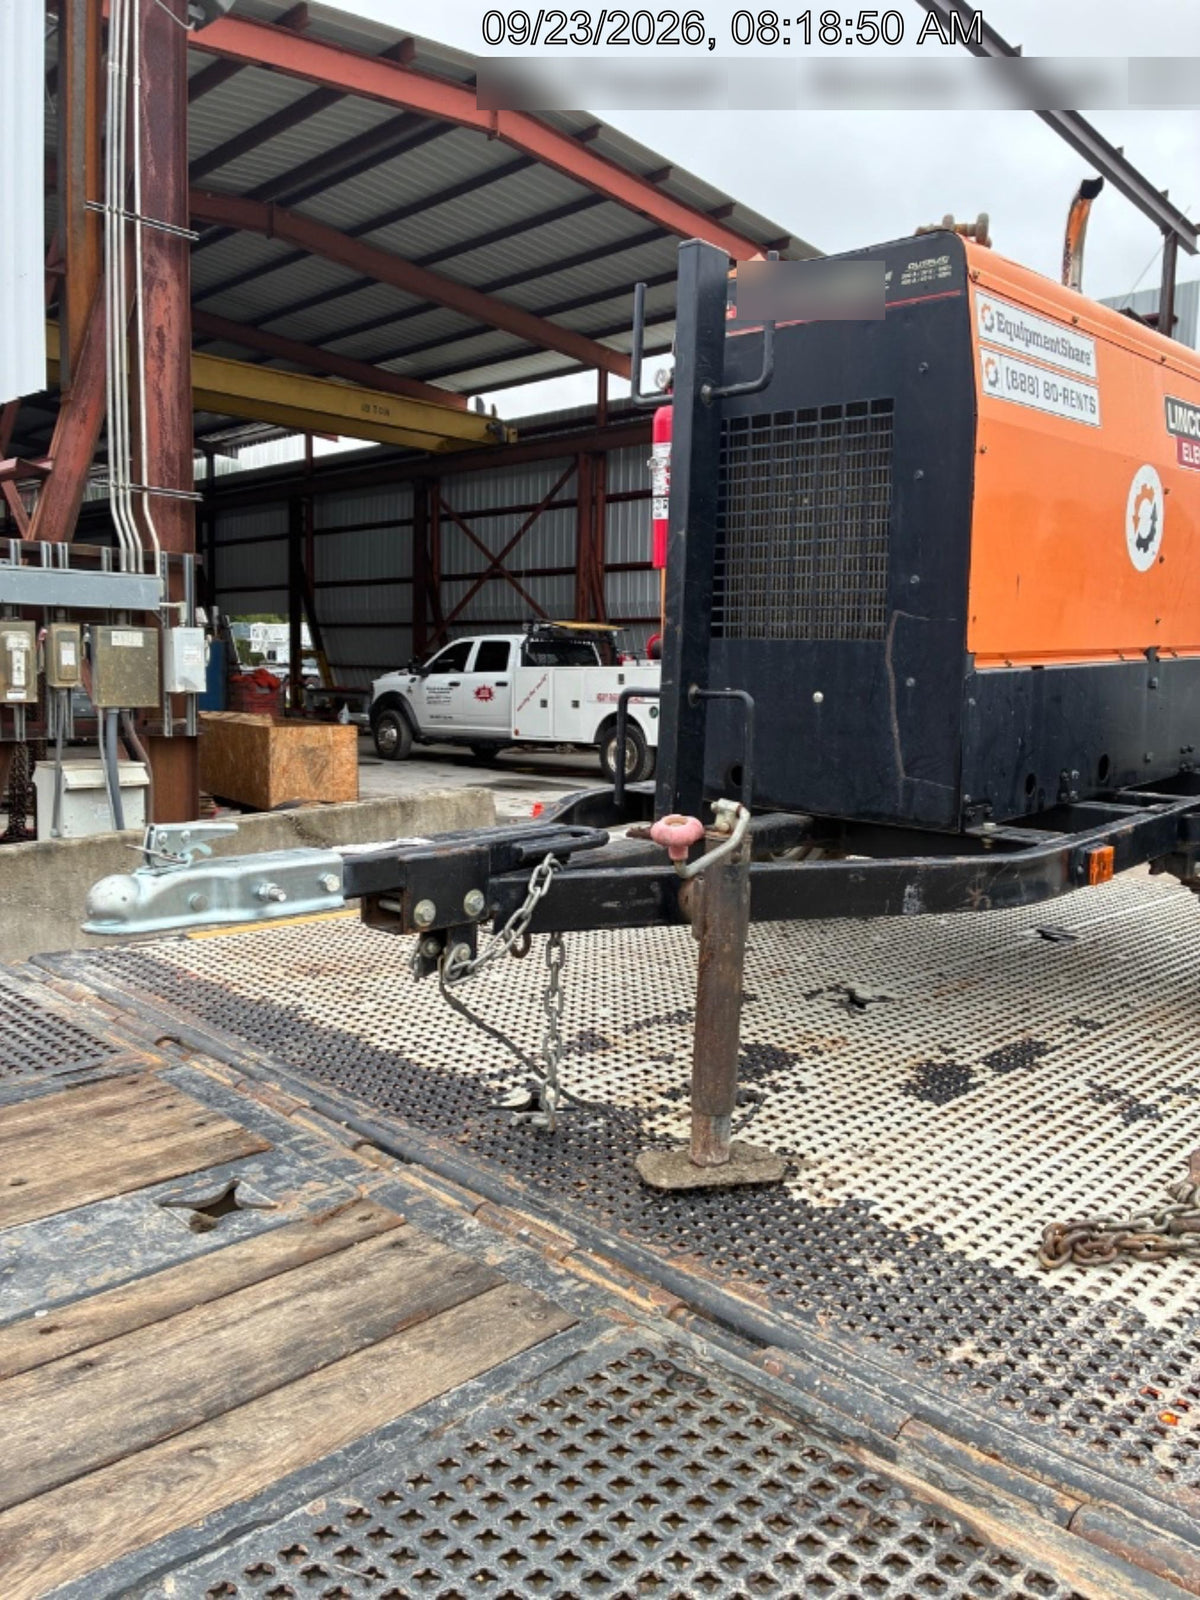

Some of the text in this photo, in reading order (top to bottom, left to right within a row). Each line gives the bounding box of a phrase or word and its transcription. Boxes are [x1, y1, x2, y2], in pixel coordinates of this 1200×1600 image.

[996, 310, 1091, 366] EquipmentShare
[1005, 366, 1097, 414] (888) 80-RENTS
